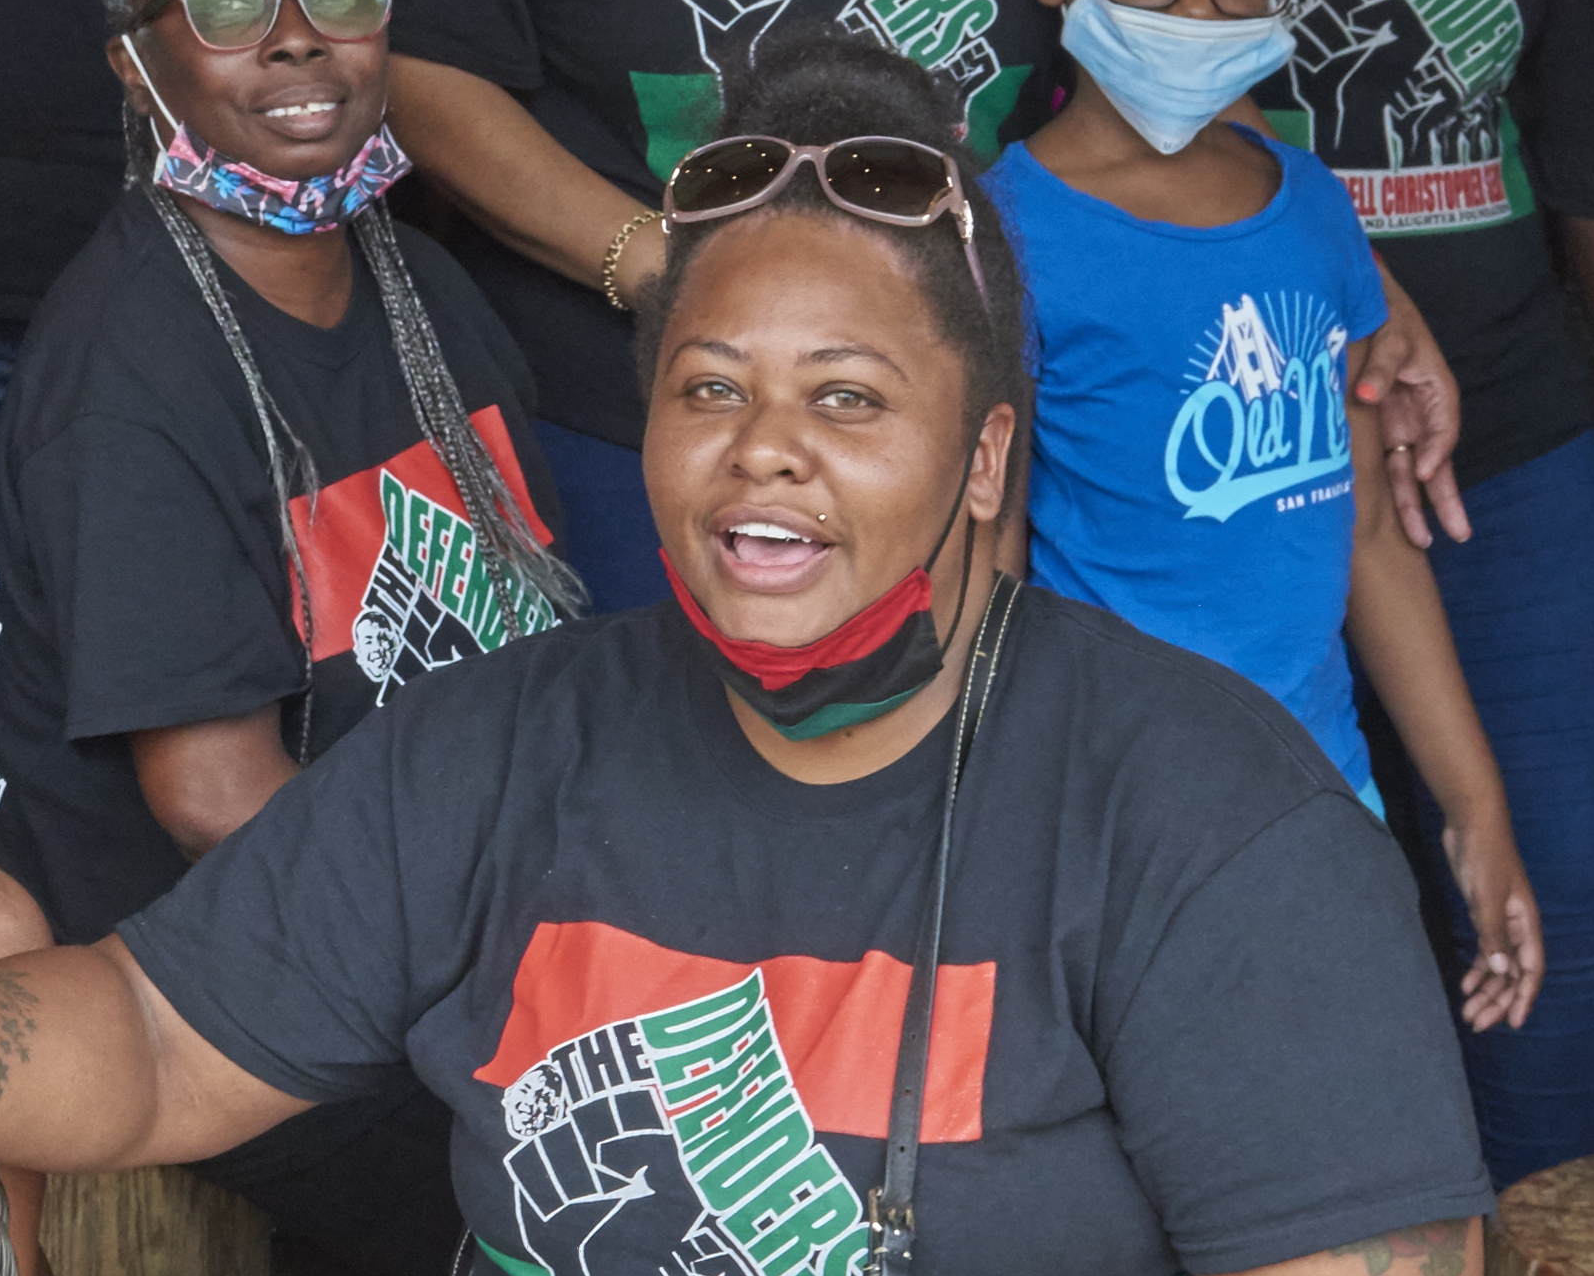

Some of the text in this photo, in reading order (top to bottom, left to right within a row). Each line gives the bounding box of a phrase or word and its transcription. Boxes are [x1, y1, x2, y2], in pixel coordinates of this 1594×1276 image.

[1165, 380, 1292, 508] Old
[1275, 493, 1306, 513] SAN
[550, 1021, 657, 1103] THE
